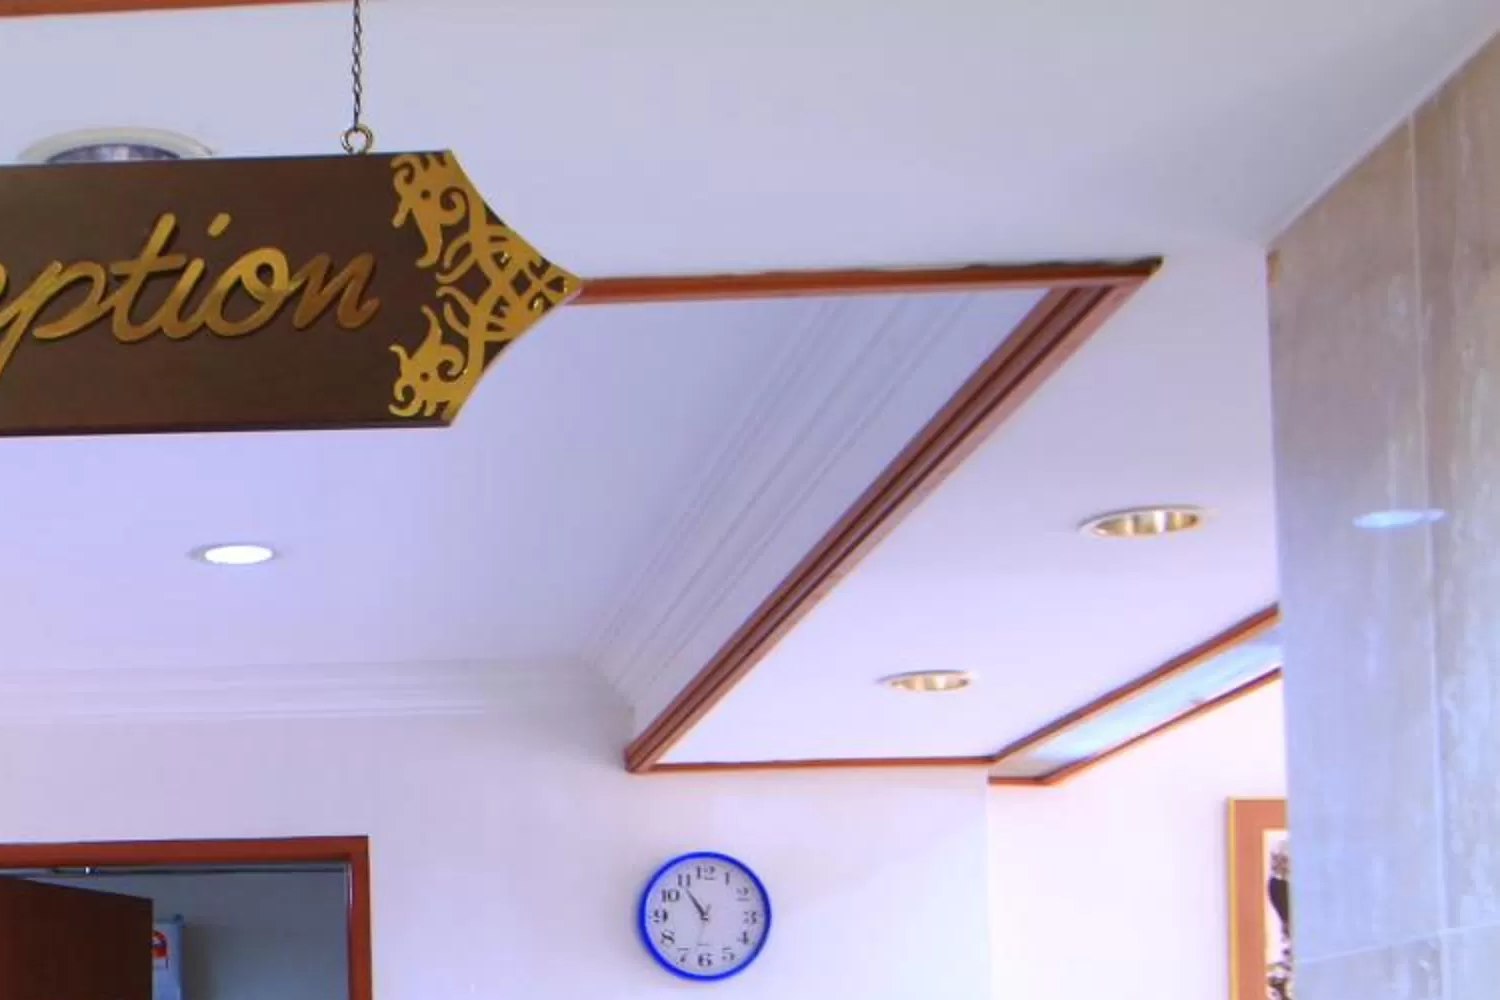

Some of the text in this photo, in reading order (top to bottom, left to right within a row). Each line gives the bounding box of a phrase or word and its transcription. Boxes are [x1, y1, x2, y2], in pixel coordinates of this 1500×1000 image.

[696, 865, 716, 880] 12
[677, 873, 691, 887] 11
[661, 888, 680, 902] 10
